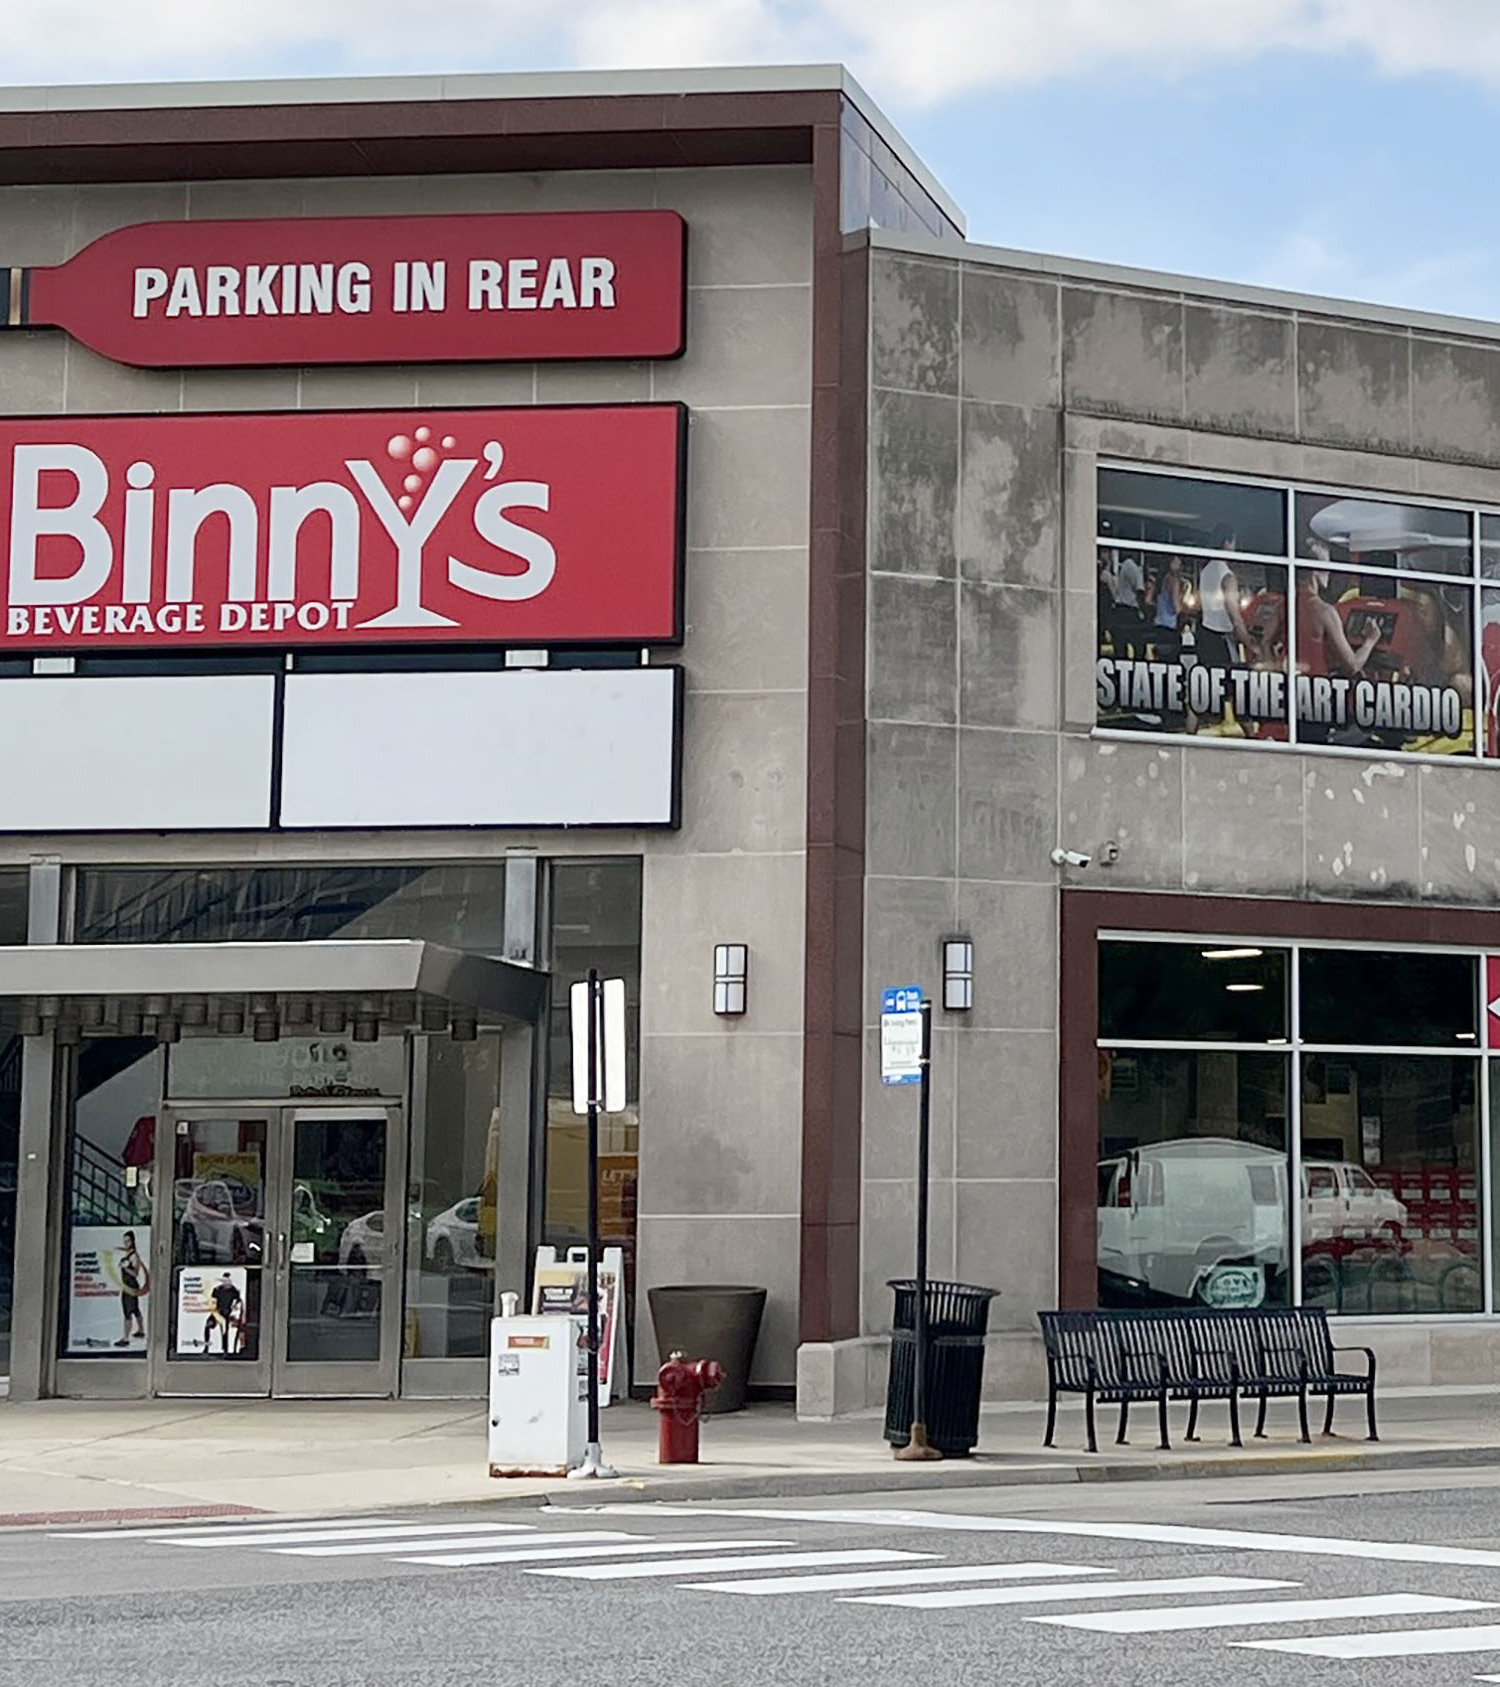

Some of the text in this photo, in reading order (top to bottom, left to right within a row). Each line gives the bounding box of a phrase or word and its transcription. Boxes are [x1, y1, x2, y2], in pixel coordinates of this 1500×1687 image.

[133, 257, 617, 318] PARKING IN REAR
[7, 600, 355, 636] BEVERAGE DEPOT
[1097, 657, 1462, 736] STATE OF THE ART CARDIO
